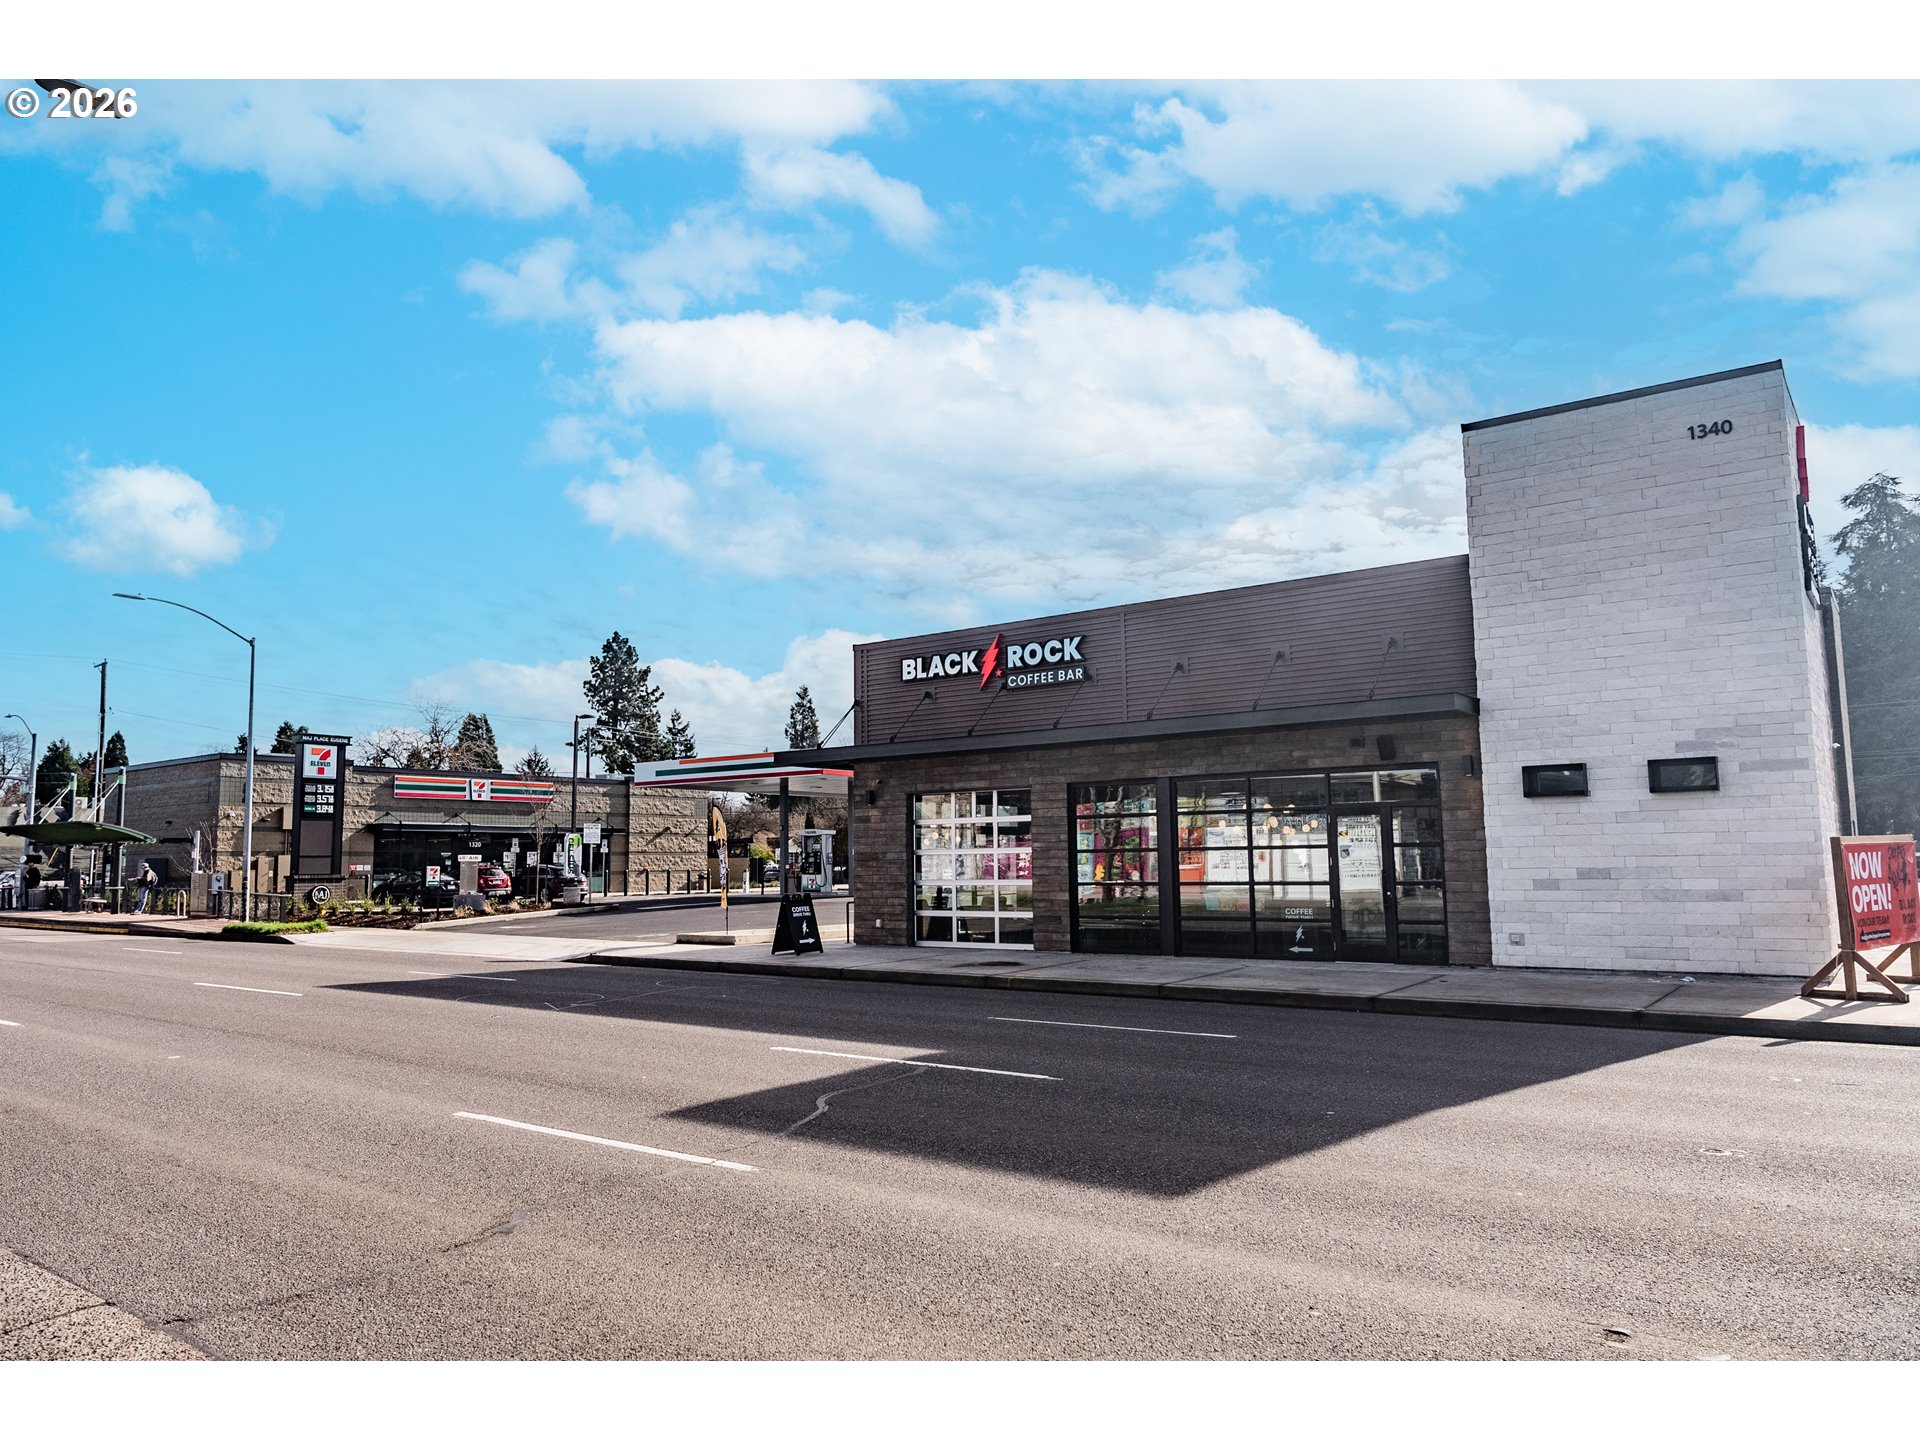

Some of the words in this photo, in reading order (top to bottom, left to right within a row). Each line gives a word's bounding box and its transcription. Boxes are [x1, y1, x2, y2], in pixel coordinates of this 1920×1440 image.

[1687, 419, 1733, 440] 1340
[902, 650, 979, 681] BLACK
[1007, 636, 1085, 668] ROCK
[1007, 670, 1054, 687] COFFEE
[1058, 668, 1083, 682] BAR
[1848, 851, 1882, 880] NOW
[1852, 883, 1892, 913] OPEN!
